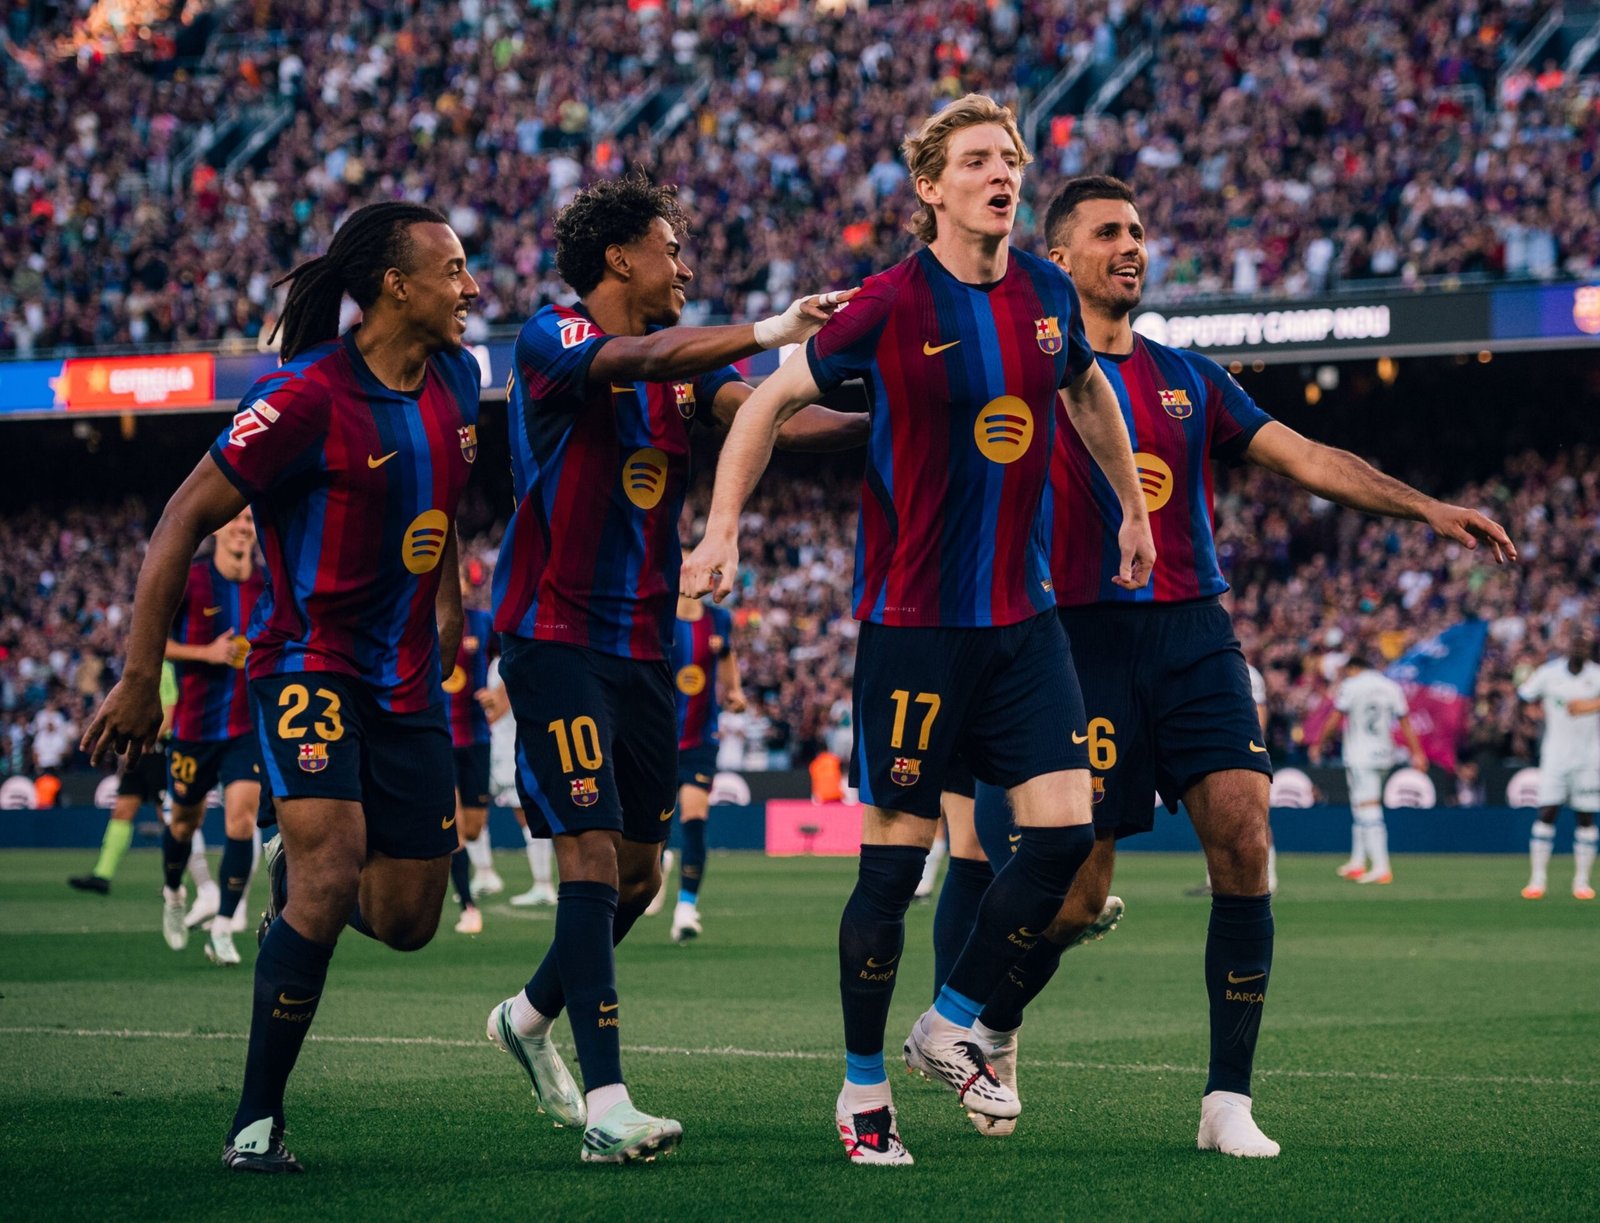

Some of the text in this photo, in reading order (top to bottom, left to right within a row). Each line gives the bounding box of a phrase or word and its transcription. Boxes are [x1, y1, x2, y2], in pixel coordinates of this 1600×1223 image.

[1166, 305, 1390, 347] SPOTIFY CAMP NOU
[278, 684, 344, 741] 23
[890, 690, 941, 750] 17
[171, 751, 197, 783] 20
[548, 715, 603, 773] 10
[1087, 717, 1117, 770] 6
[1225, 989, 1264, 1004] BARÇA
